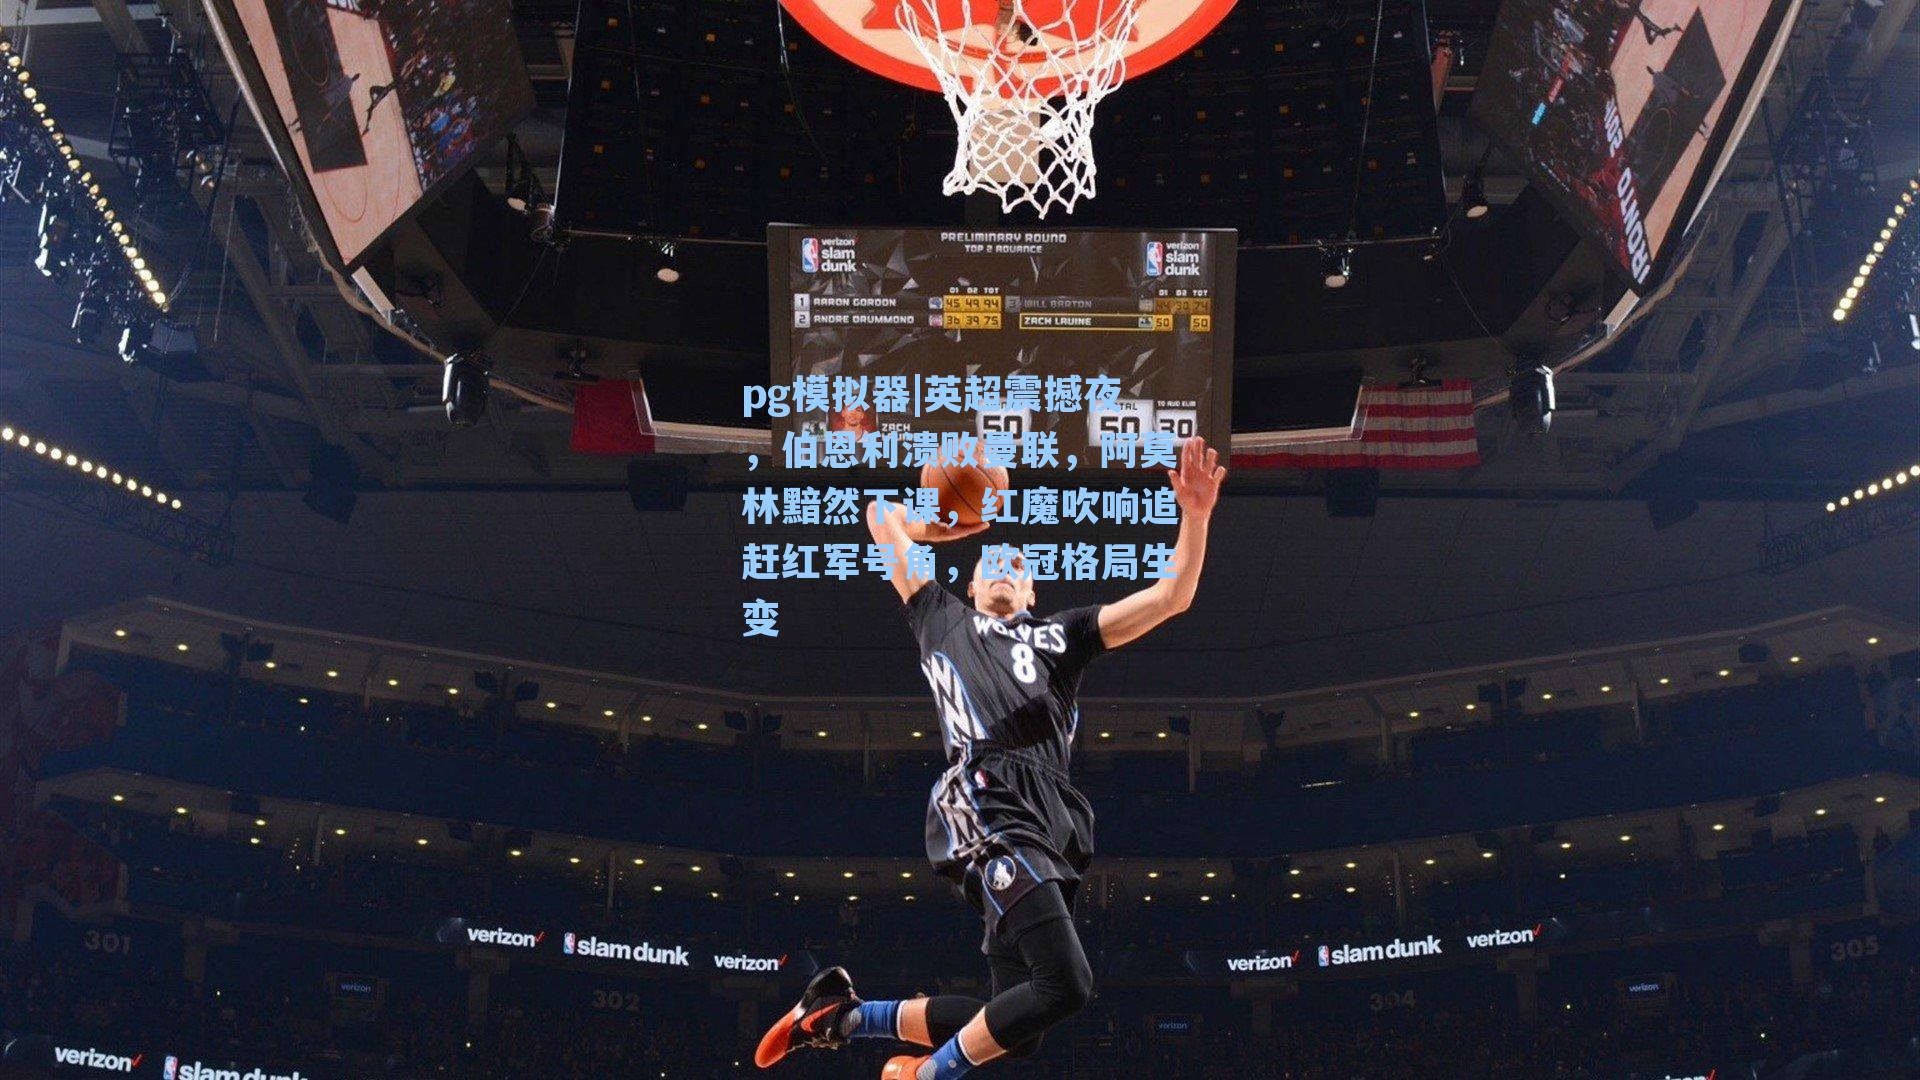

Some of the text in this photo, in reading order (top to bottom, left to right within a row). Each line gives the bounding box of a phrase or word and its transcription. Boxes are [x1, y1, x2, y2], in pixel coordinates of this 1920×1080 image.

[821, 237, 855, 246] verizon
[941, 232, 1067, 243] PRELIMINARY ROUND
[1166, 241, 1199, 250] verizon
[821, 247, 855, 259] slam
[965, 245, 1042, 253] TOP 2 ADVANCE
[1166, 250, 1199, 263] slam
[821, 260, 857, 272] dunk
[1165, 263, 1200, 275] dunk
[813, 298, 850, 306] AARON
[853, 298, 897, 306] GORDON
[946, 299, 960, 308] 45
[965, 299, 979, 308] 49
[984, 299, 999, 308] 94
[1024, 300, 1047, 308] WILL
[1050, 300, 1092, 309] BARTON
[813, 315, 849, 323] ANDRE
[852, 315, 914, 324] DRUMMOND
[966, 316, 979, 324] 39
[984, 316, 999, 324] 75
[1024, 317, 1052, 325] ZACH
[1156, 317, 1170, 327] 50
[1193, 317, 1208, 327] 50
[881, 423, 911, 431] ZACH
[982, 414, 1023, 440] 50
[1101, 416, 1139, 440] 50
[1160, 419, 1193, 438] 30
[973, 616, 1066, 653] WOLVES
[1011, 643, 1037, 683] 8
[467, 926, 535, 948] verizon
[1467, 928, 1534, 949] verizon
[577, 936, 689, 966] slam dunk
[1332, 935, 1442, 964] slam dunk
[714, 952, 779, 971] verizon
[1227, 951, 1292, 971] verizon
[54, 1046, 132, 1072] verizon
[178, 1061, 240, 1080] slam
